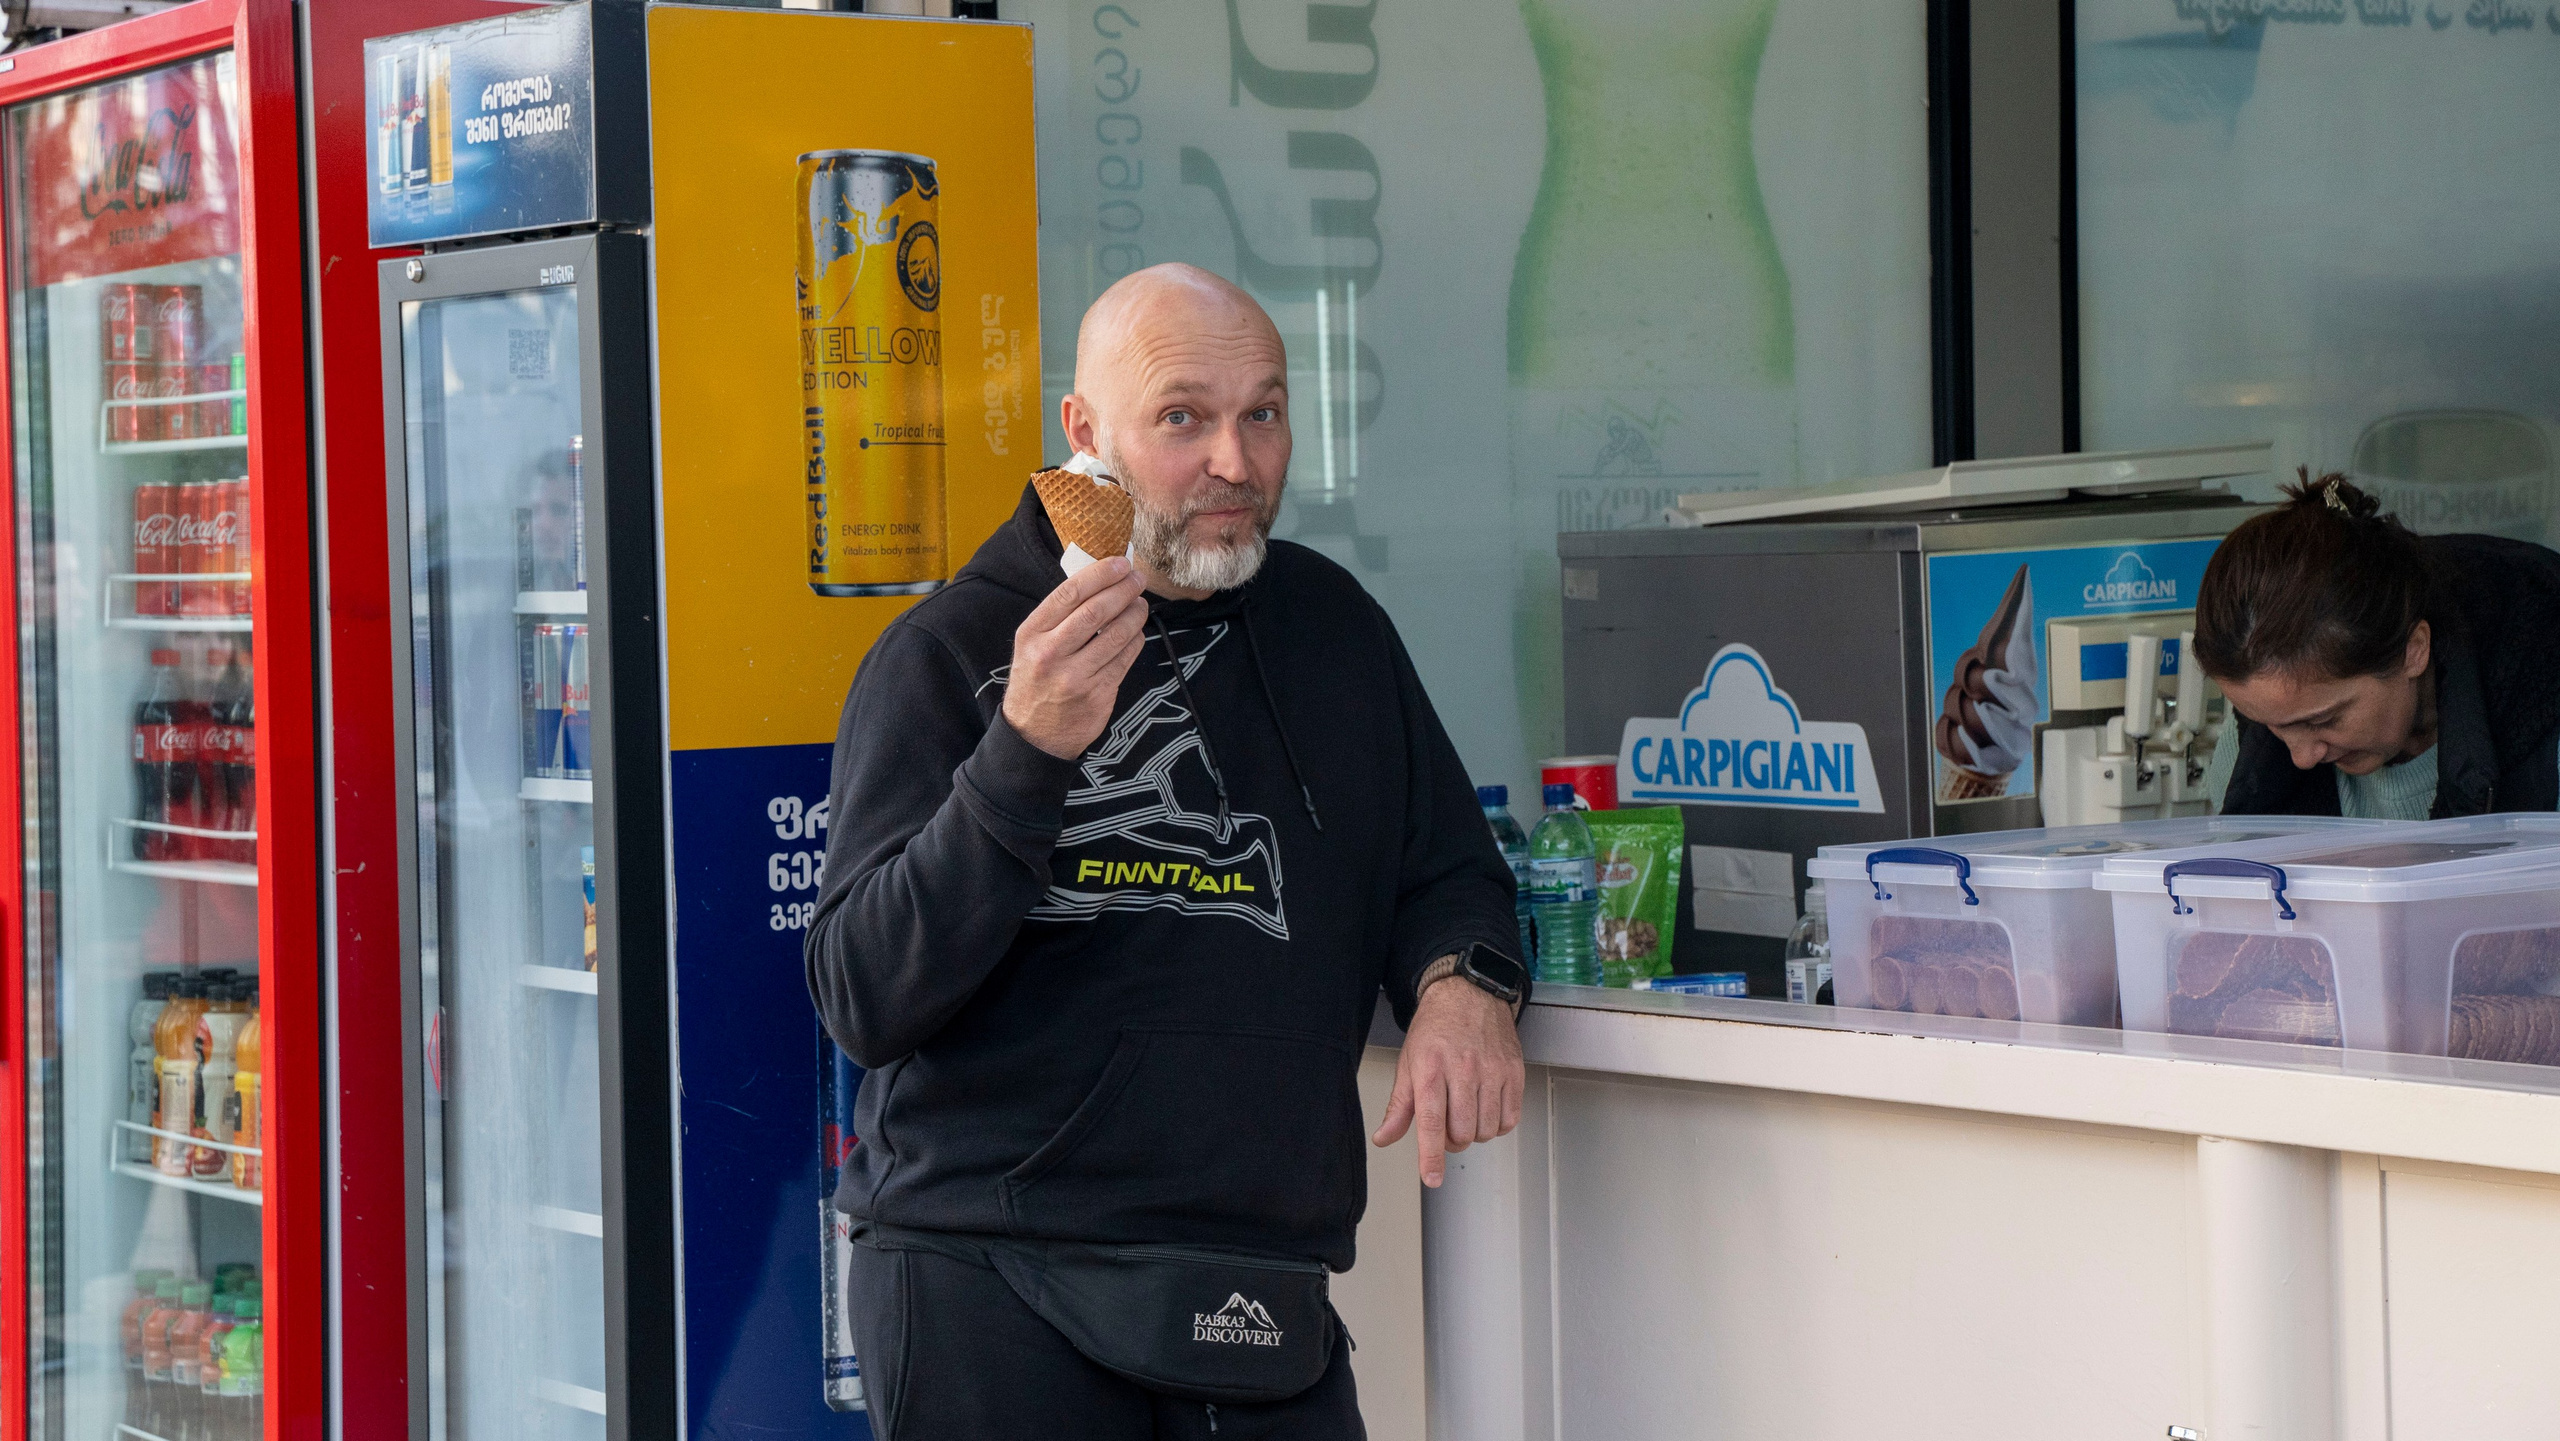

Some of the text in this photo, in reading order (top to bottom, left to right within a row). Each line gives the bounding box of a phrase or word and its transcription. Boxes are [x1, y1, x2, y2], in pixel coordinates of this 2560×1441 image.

[481, 75, 553, 112] რომელია
[465, 102, 571, 145] შენი ფრთები?
[801, 305, 822, 321] THE
[802, 326, 941, 366] YELLOW
[804, 371, 868, 391] EDITION
[874, 422, 925, 441] Tropical
[805, 406, 829, 574] Red Bull
[842, 522, 922, 537] ENERGY DRINK
[843, 545, 878, 556] Vitalizes
[880, 544, 903, 558] body
[905, 543, 921, 555] and
[2083, 579, 2177, 602] CARPIGIANI
[1631, 737, 1856, 793] CARPIGIANI
[1193, 1312, 1246, 1328] КАВКАЗ
[1192, 1326, 1284, 1347] DISCOVERY
